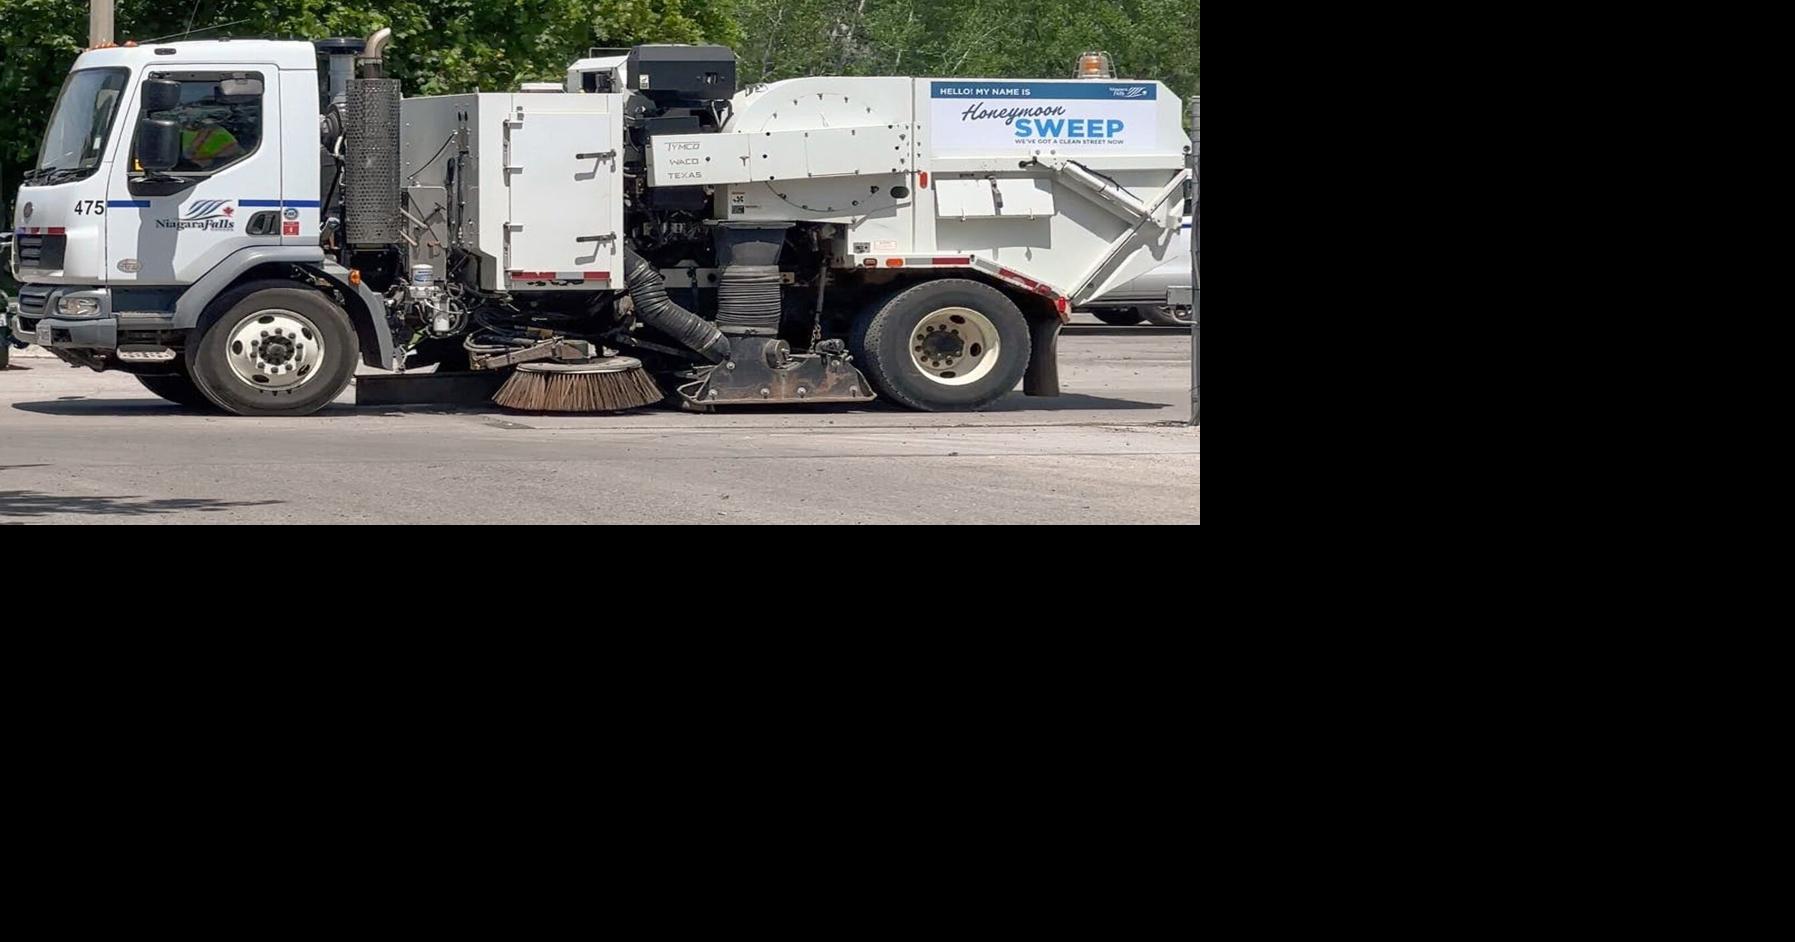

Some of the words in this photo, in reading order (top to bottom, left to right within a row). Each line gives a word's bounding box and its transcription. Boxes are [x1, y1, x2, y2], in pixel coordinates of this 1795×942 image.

[992, 88, 1020, 96] NAME
[1021, 88, 1031, 96] IS
[961, 102, 1066, 126] Honeymoon
[1015, 119, 1125, 138] SWEEP
[664, 141, 701, 152] TYMCO
[667, 171, 703, 180] TEXAS
[74, 200, 105, 216] 475
